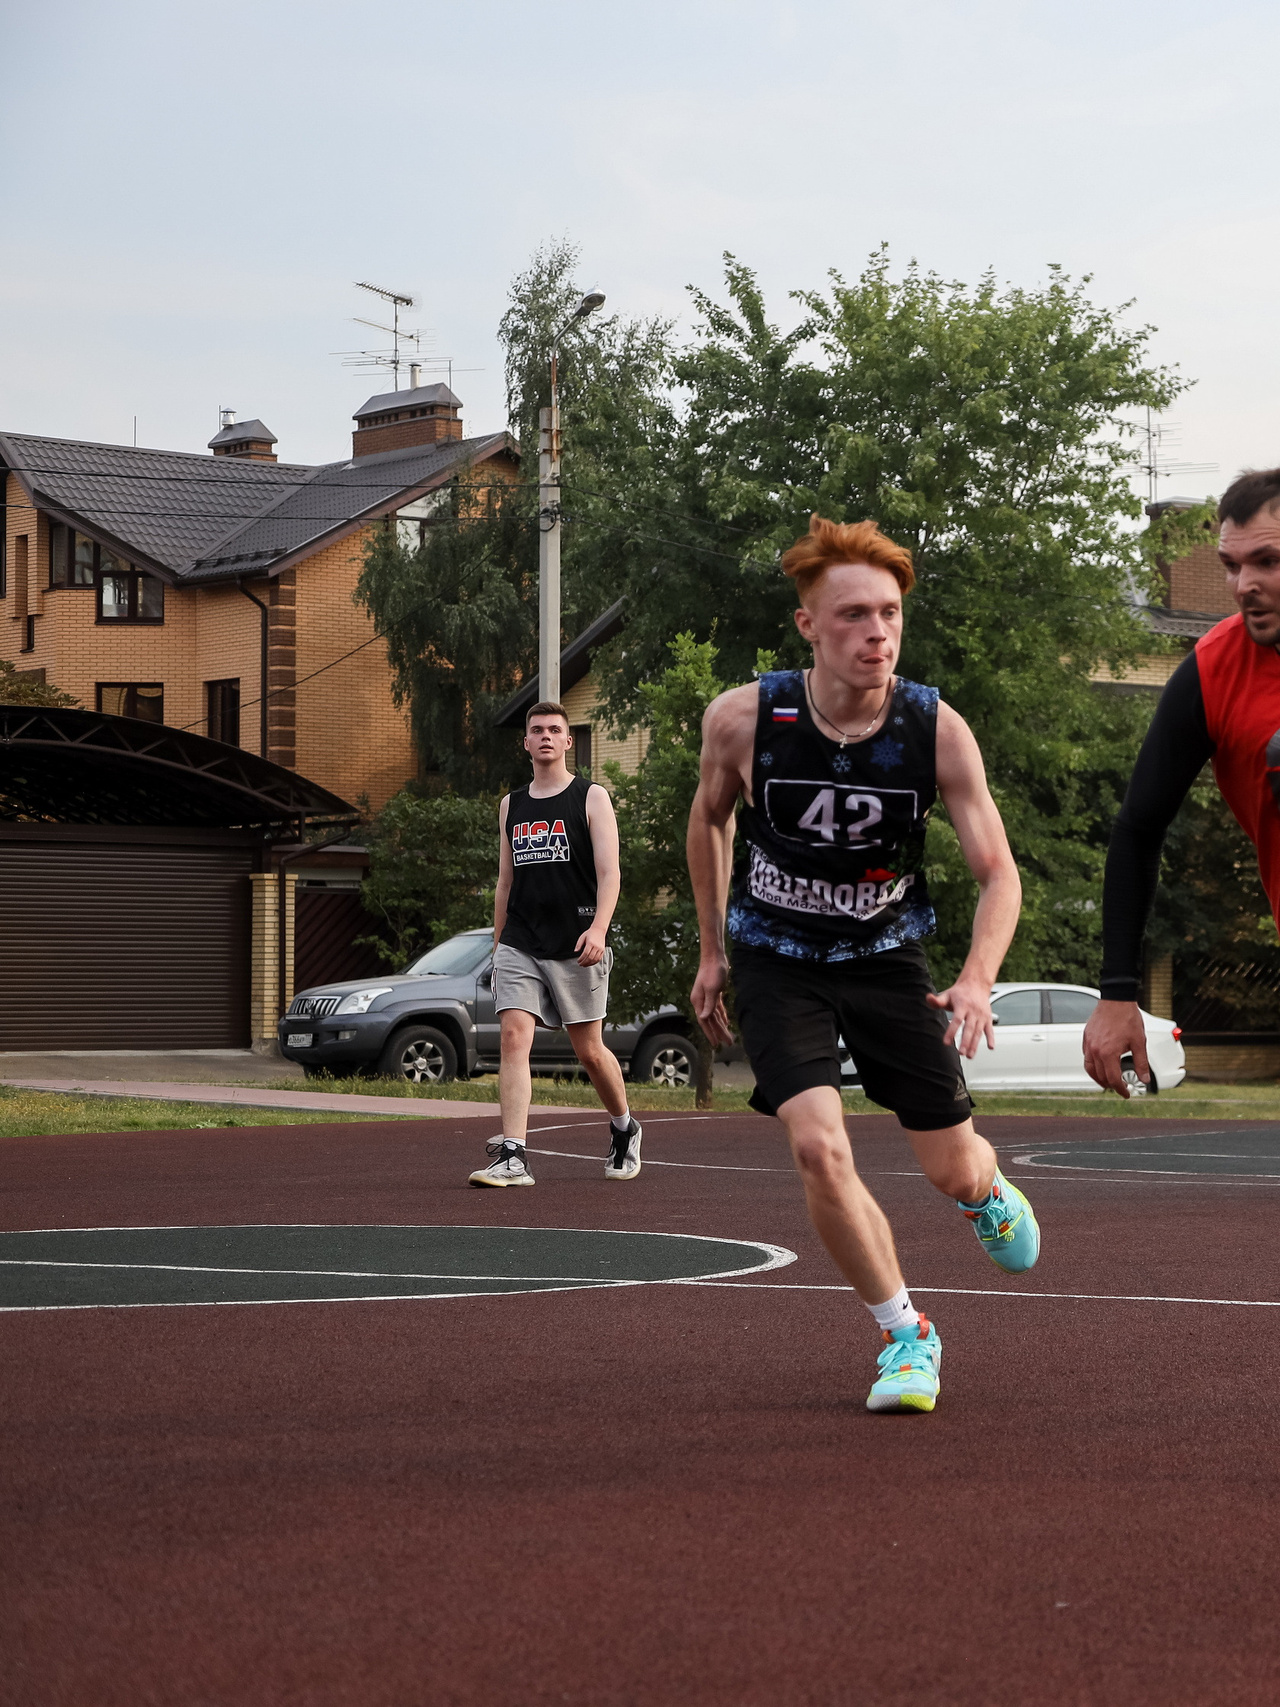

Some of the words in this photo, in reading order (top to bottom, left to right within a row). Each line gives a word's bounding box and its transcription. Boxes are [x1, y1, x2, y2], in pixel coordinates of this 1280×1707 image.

[797, 788, 882, 846] 42
[512, 820, 569, 852] USA
[516, 851, 552, 862] BASKETBALL
[754, 884, 782, 904] Моя
